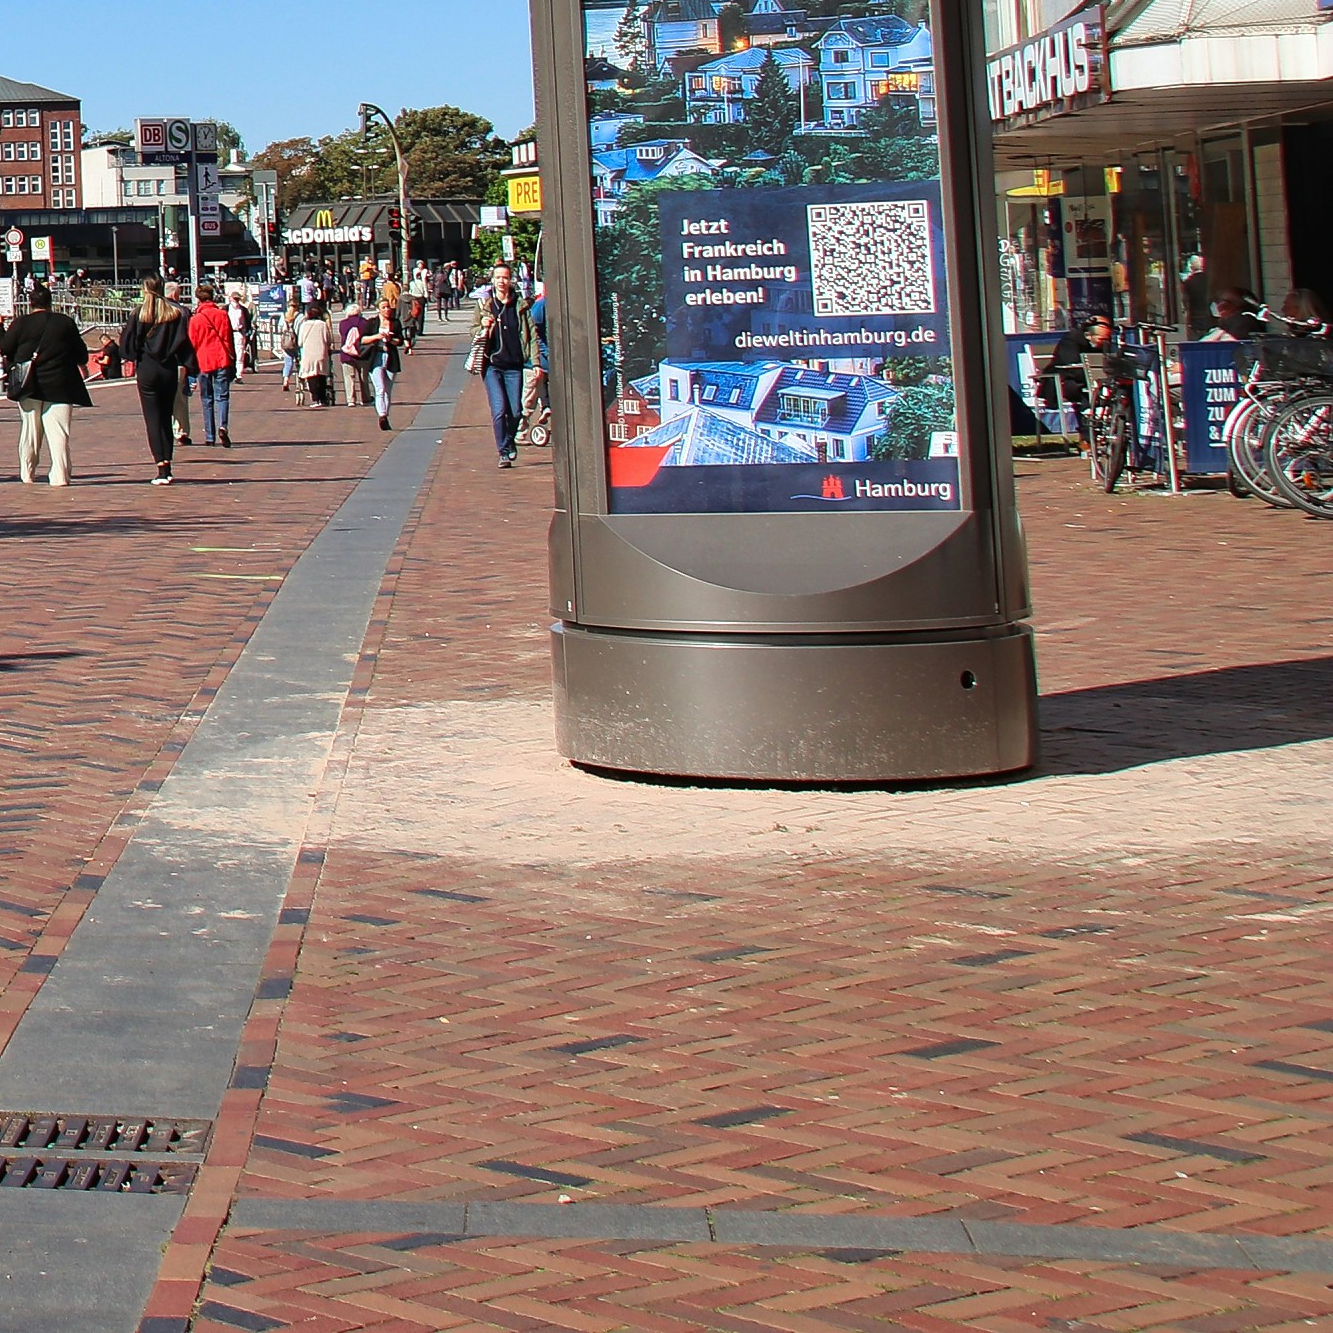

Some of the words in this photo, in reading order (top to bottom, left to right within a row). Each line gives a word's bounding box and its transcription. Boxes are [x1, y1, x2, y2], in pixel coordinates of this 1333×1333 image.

[144, 127, 161, 143] DB
[516, 181, 538, 204] PRE
[203, 222, 217, 230] BUS
[681, 218, 729, 236] Jetzt
[682, 239, 785, 259] Frankreich
[684, 266, 702, 282] in
[707, 263, 796, 283] Hamburg
[685, 285, 764, 306] erleben!
[735, 326, 936, 349] dieweltinhamburg.de
[1204, 369, 1235, 384] ZUM
[1205, 388, 1236, 402] ZUM
[617, 399, 625, 417] Marc
[1209, 426, 1220, 440] &
[855, 478, 952, 501] Hamburg
